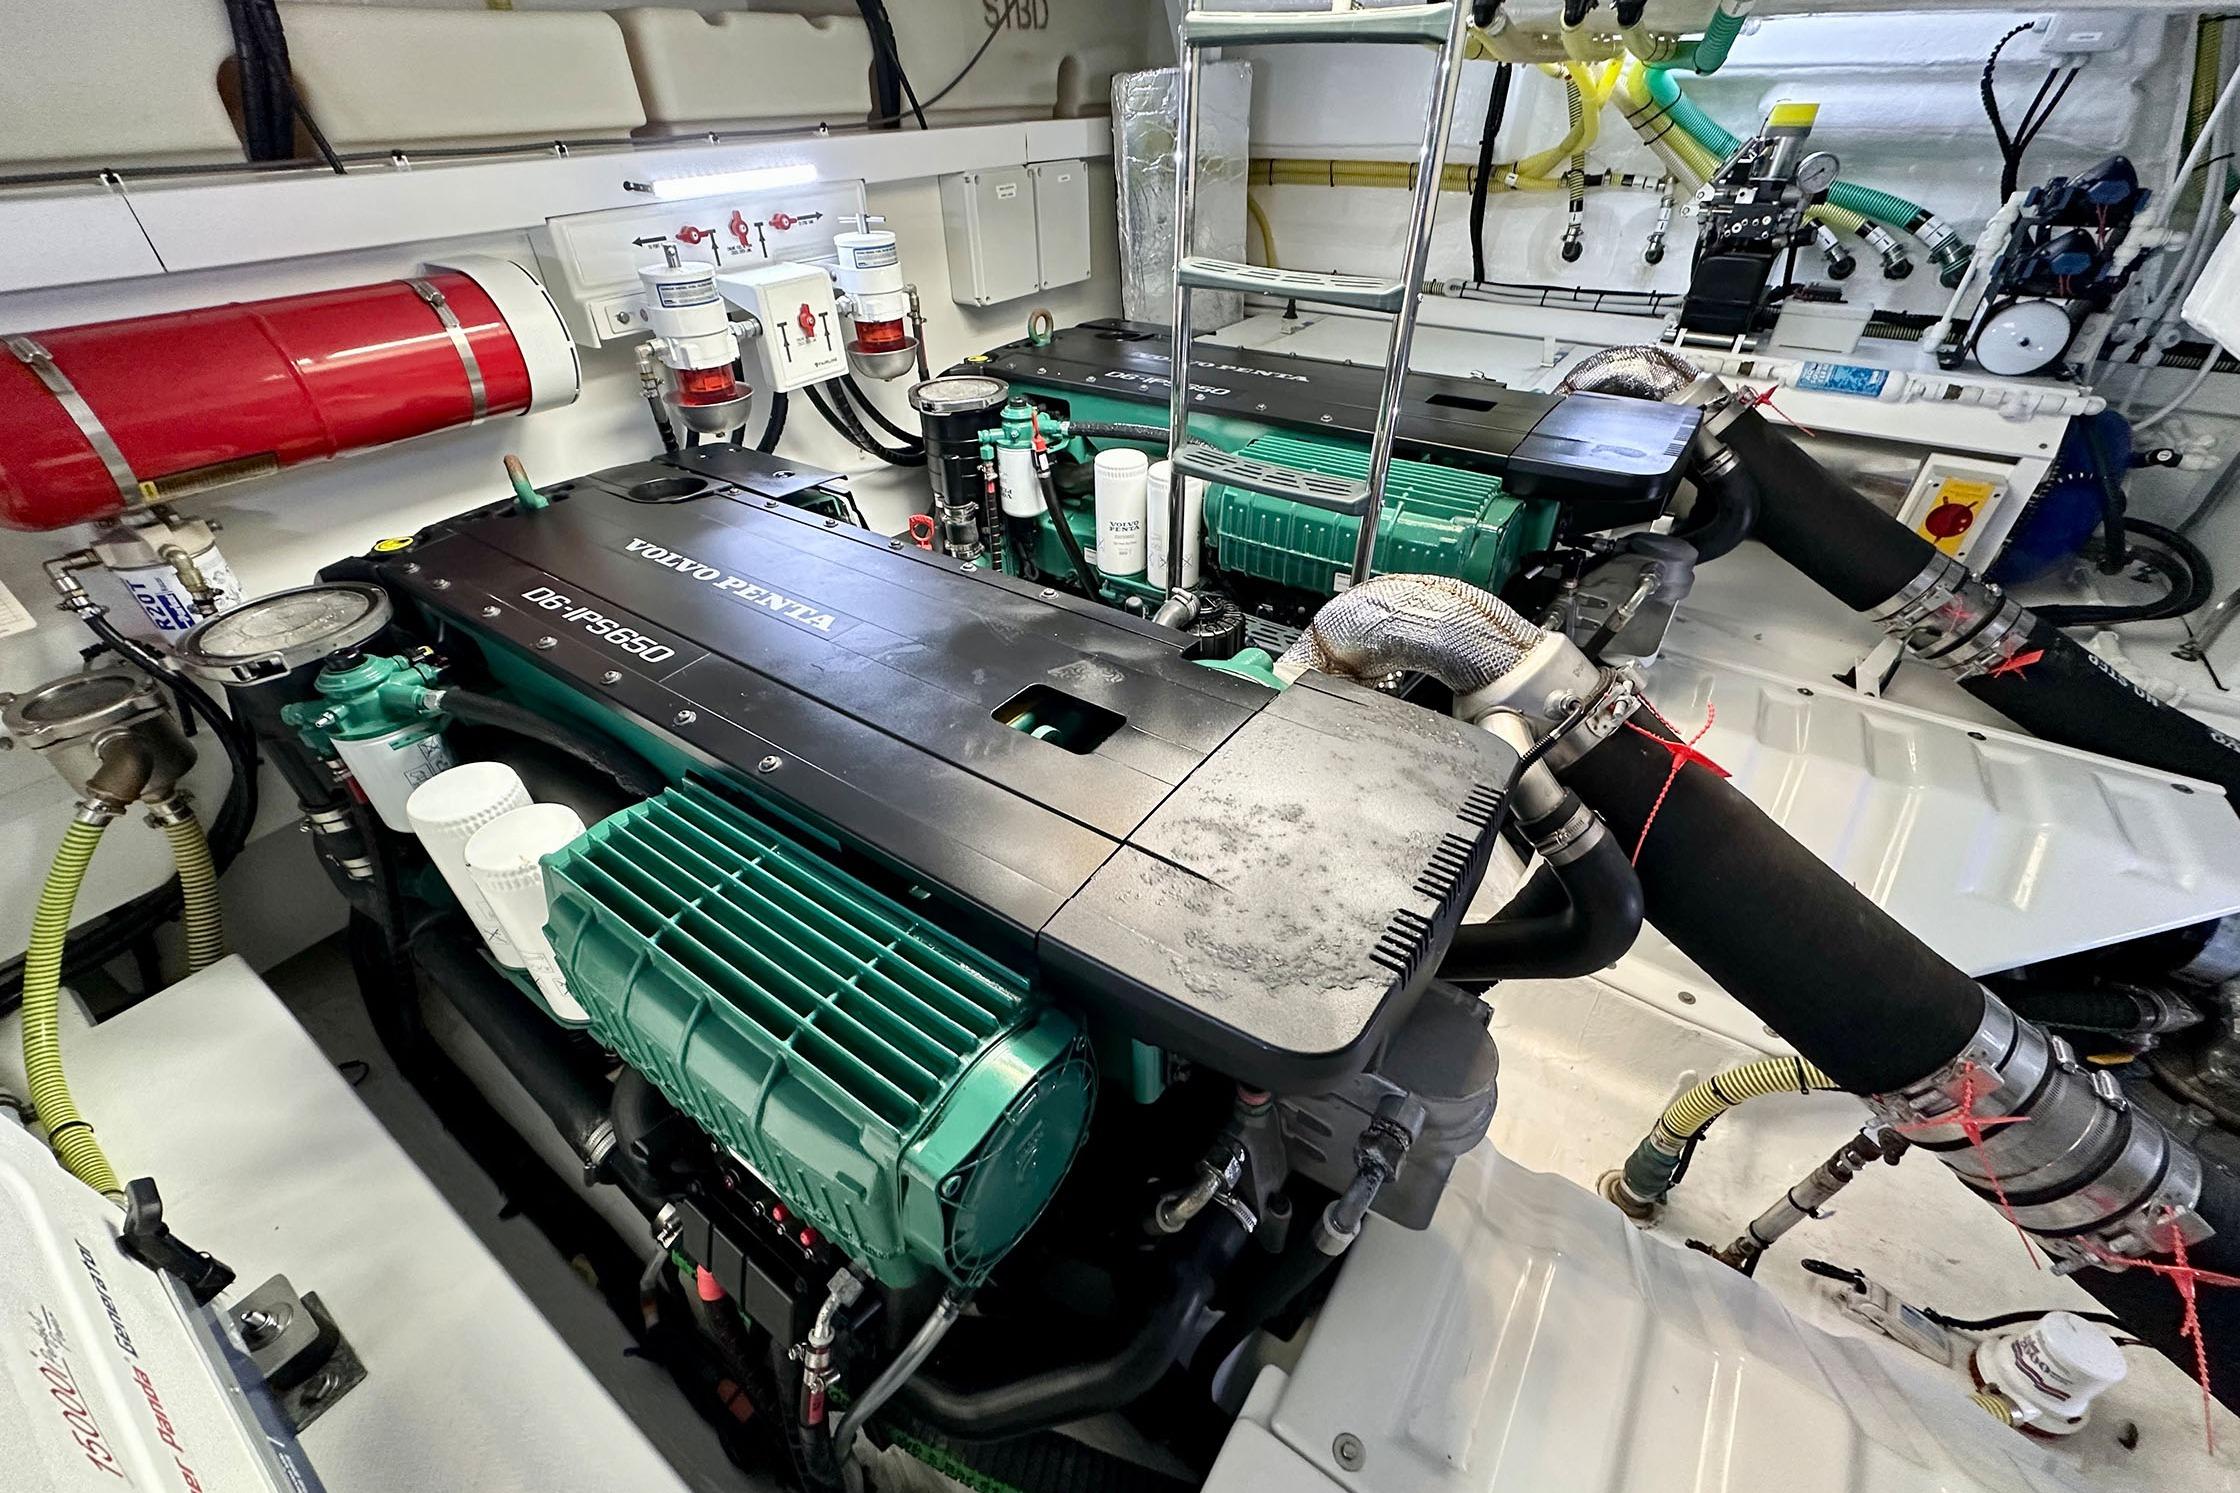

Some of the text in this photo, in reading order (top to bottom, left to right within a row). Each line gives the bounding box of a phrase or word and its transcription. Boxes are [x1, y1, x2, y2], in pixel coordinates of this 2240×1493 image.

[1215, 364, 1310, 383] PENTA
[126, 579, 177, 631] R20T
[520, 586, 676, 664] D6-IPS650
[625, 537, 837, 633] VOLVO PENTA
[74, 1238, 139, 1359] Generator
[132, 1365, 184, 1453] Panda
